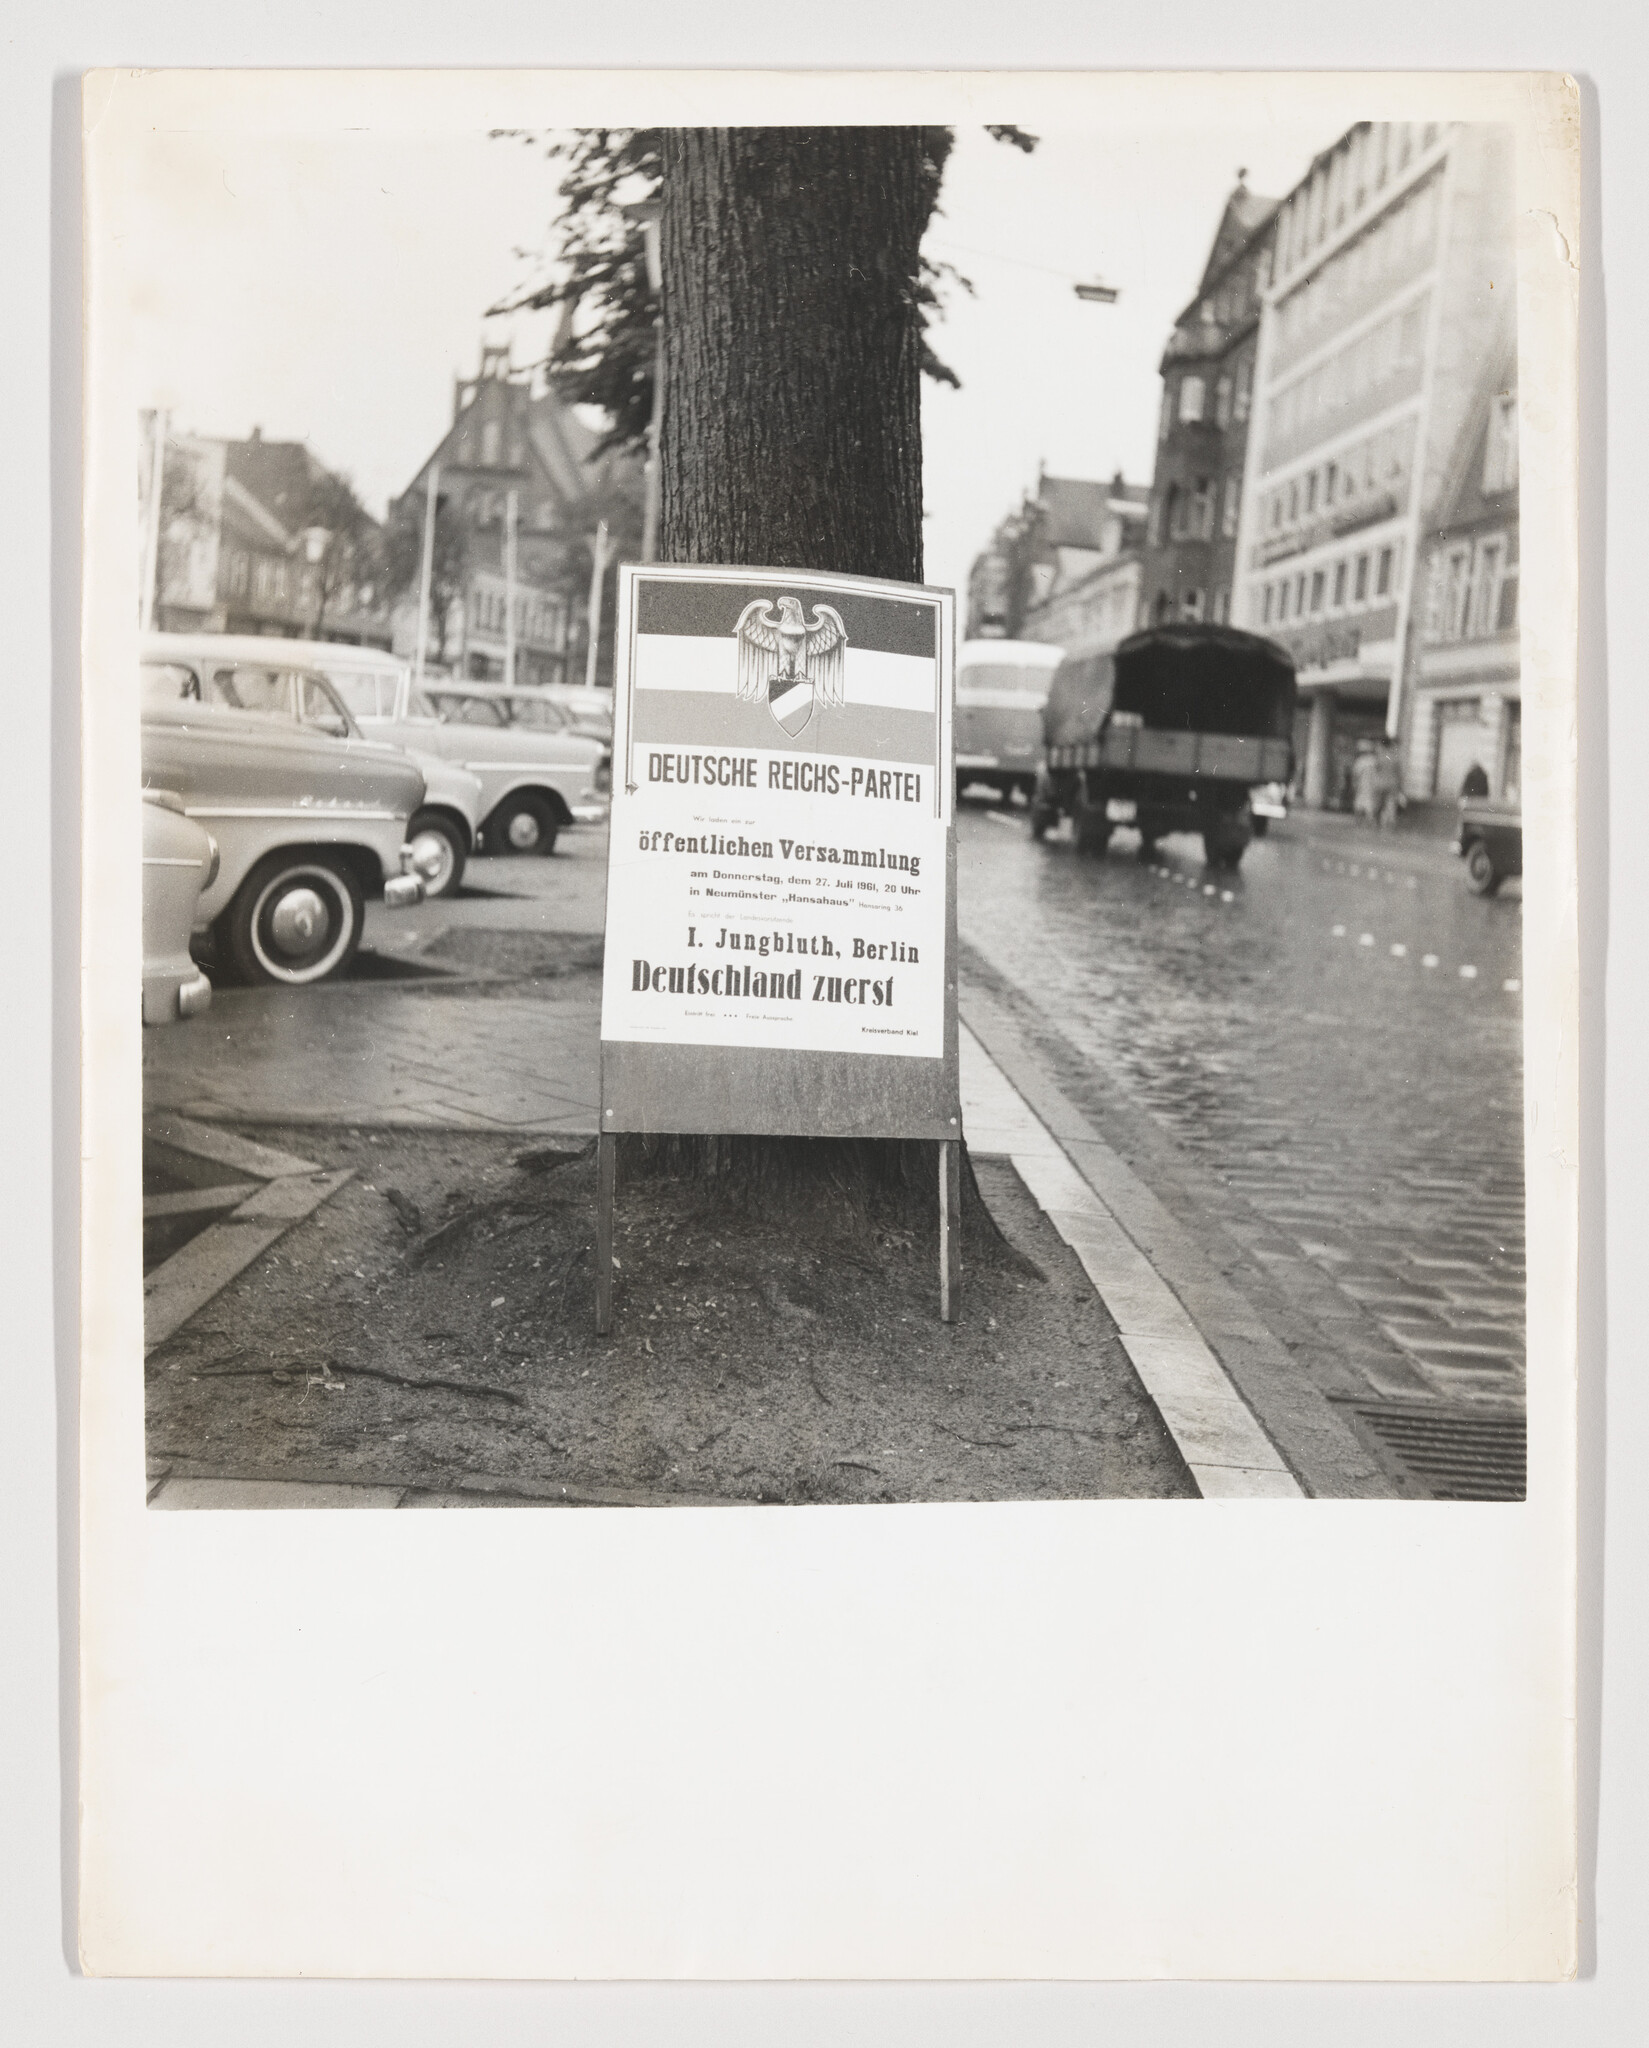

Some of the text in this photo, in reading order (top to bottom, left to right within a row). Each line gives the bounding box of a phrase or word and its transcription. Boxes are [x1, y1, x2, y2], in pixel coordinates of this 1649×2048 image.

[649, 753, 920, 802] DEUTSCHE REICHS-PARTEI
[708, 816, 728, 824] laden
[639, 831, 920, 876] öffentlichen Versammlung
[691, 870, 921, 896] am Donnerstag, dem 27. Juli 1961, 20 Uhr
[690, 887, 700, 896] in
[706, 888, 777, 902] Neumünster
[859, 902, 890, 911] Hansaring
[894, 904, 904, 912] 36
[688, 927, 920, 964] I. Jungbluth, Berlin
[632, 960, 894, 1006] Deutschland zuerst
[862, 1027, 919, 1037] Kreisverband Kiel
